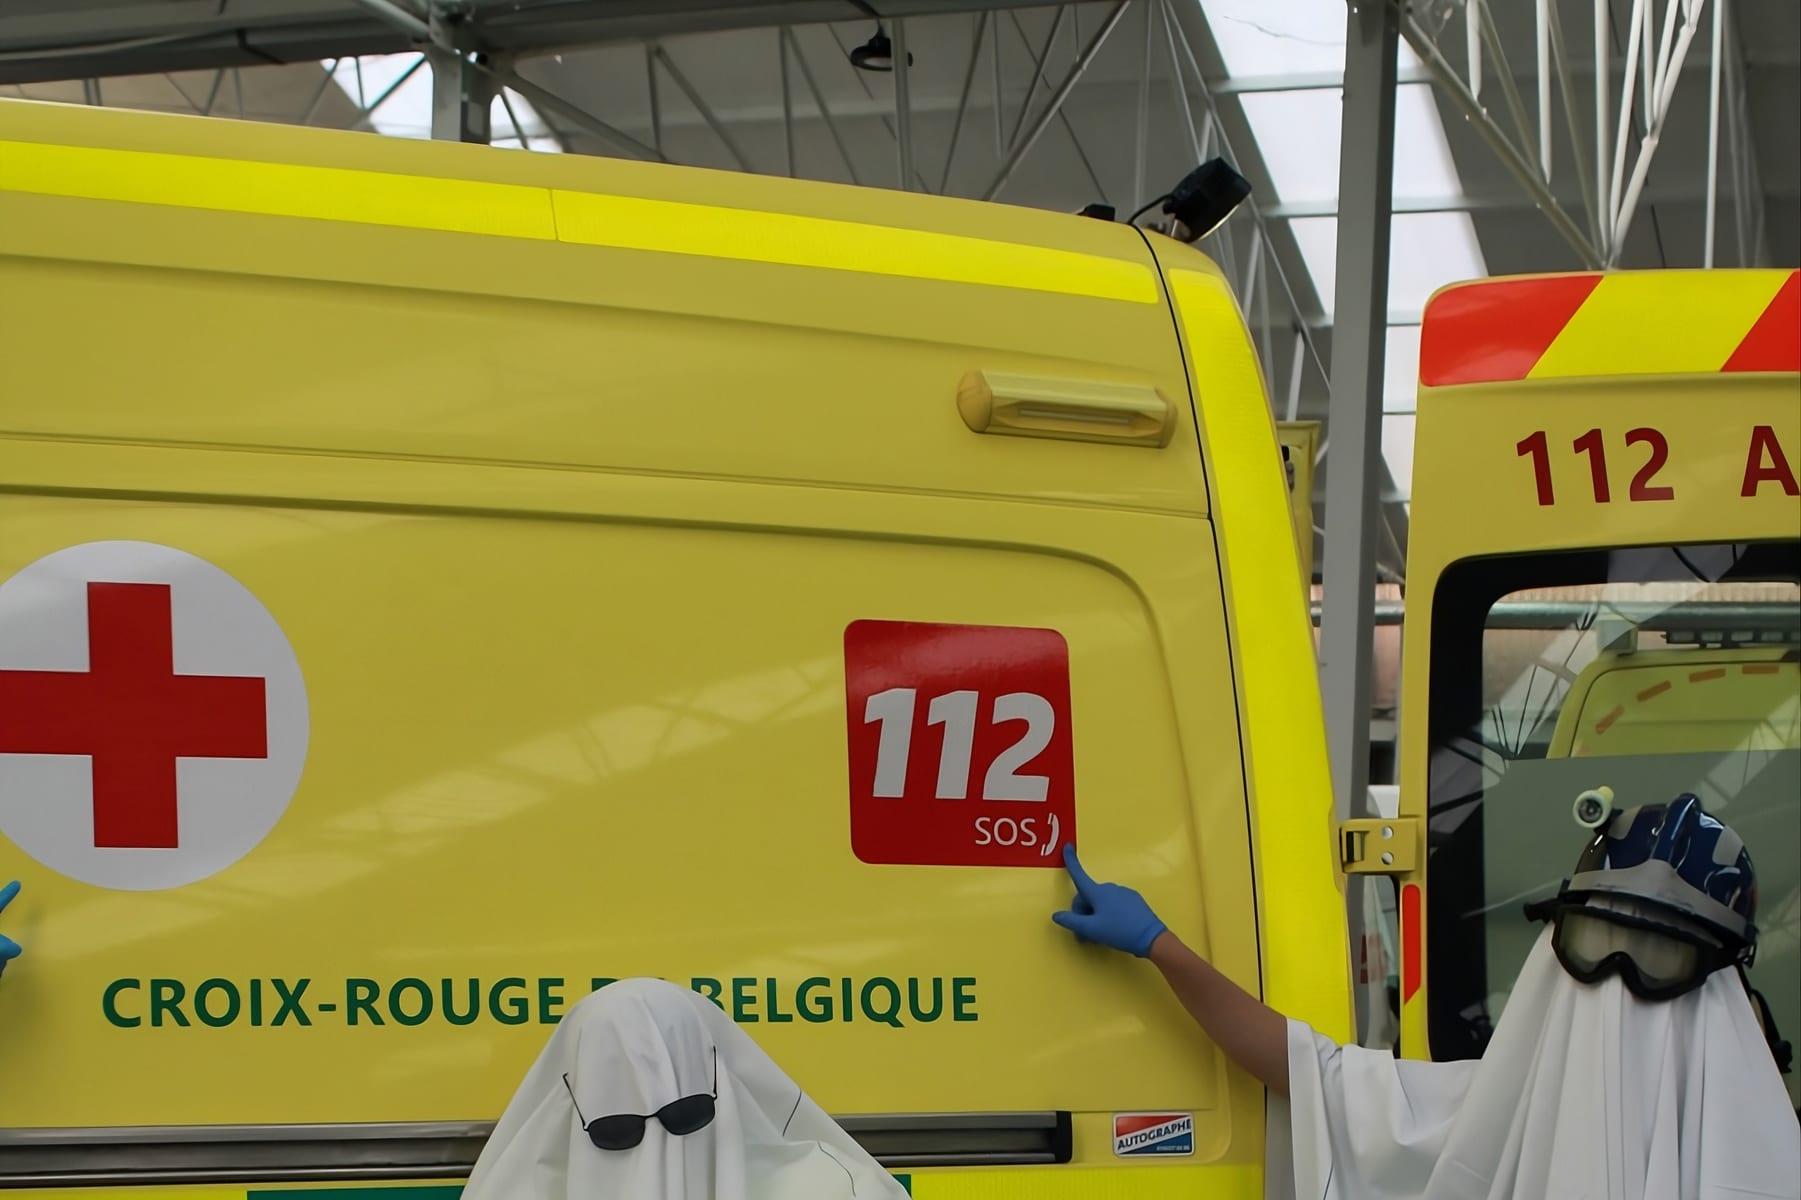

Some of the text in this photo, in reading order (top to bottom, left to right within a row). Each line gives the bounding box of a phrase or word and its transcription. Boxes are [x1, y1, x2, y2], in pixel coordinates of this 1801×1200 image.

[1516, 428, 1675, 506] 112
[864, 687, 1055, 802] 112
[974, 816, 1038, 847] SOS
[102, 977, 565, 1026] CROIX-ROUGE
